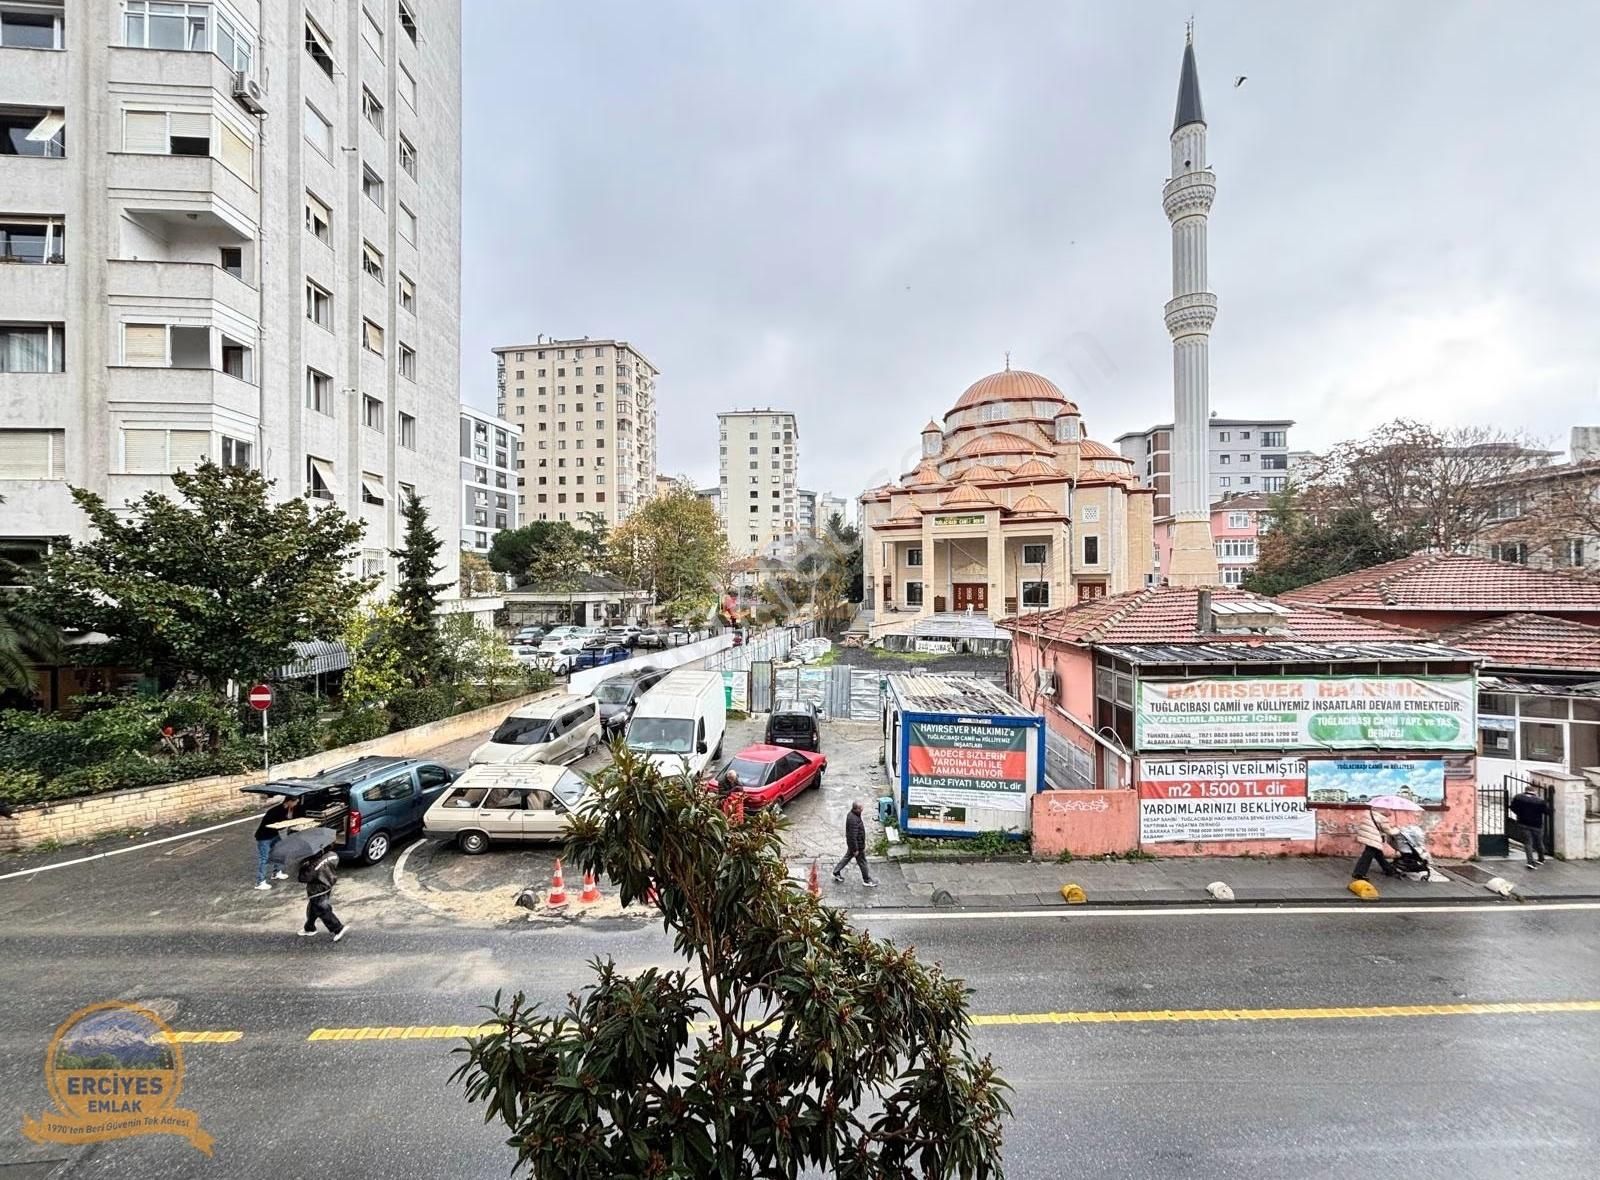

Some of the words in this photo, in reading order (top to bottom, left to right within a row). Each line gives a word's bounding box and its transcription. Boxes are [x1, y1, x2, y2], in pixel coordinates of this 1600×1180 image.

[1167, 682, 1303, 699] HAYIRSEVER
[1150, 701, 1211, 713] TUĞLACIBAŞI
[1214, 701, 1241, 712] CAMİİ
[1243, 703, 1254, 712] ve
[1256, 699, 1310, 712] KÜLLİYEMİZ
[1312, 699, 1366, 712] İNŞAATLARI
[1369, 700, 1401, 711] DEVAM
[1404, 700, 1463, 712] ETMEKTEDİR.
[1151, 714, 1249, 724] YARDIMLARINIZ
[920, 723, 969, 734] HAYIRSEVER
[970, 726, 1015, 736] HALKIMIZ'a
[927, 734, 960, 742] TUĞLACIBAŞI
[929, 749, 964, 758] SADECE
[932, 758, 987, 768] YARDIMLARI
[1148, 764, 1175, 776] HALI
[1178, 761, 1229, 778] SİPARİŞİ
[1233, 761, 1306, 777] VERİLMİŞTİR
[931, 766, 1004, 778] TAMAMLANIYOR
[912, 777, 932, 785] HALI
[933, 778, 945, 786] m2
[975, 780, 997, 789] 1.500
[999, 781, 1009, 790] TL
[1010, 782, 1021, 790] dir
[1168, 783, 1192, 797] m2
[1200, 782, 1240, 797] 1.500
[1243, 782, 1263, 796] TL
[1266, 781, 1287, 796] dir
[1143, 802, 1236, 815] YARDIMLARINIZI
[1240, 799, 1312, 813] BEKLİYORU
